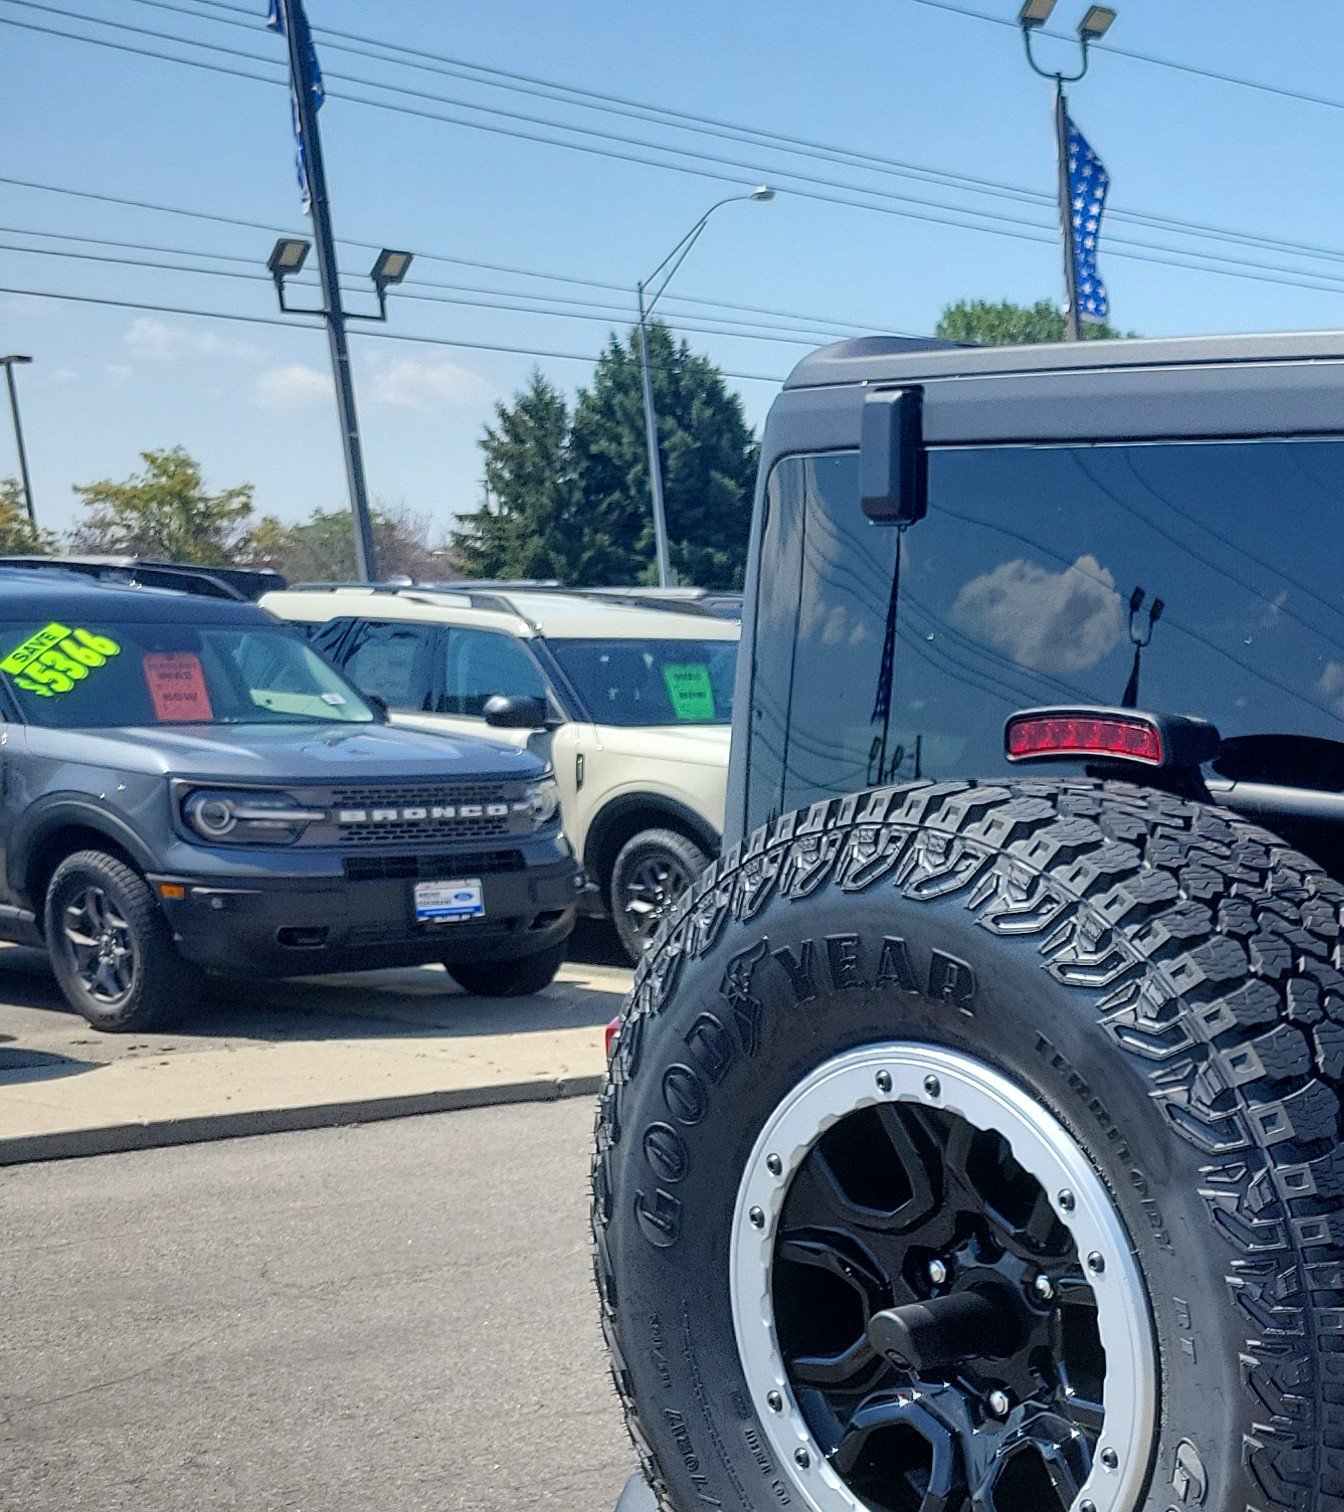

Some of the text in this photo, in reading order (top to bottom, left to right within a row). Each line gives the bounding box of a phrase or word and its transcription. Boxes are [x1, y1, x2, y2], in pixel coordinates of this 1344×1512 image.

[12, 631, 54, 663] SAVE
[13, 627, 121, 698] $5366
[338, 803, 509, 823] BRONCO
